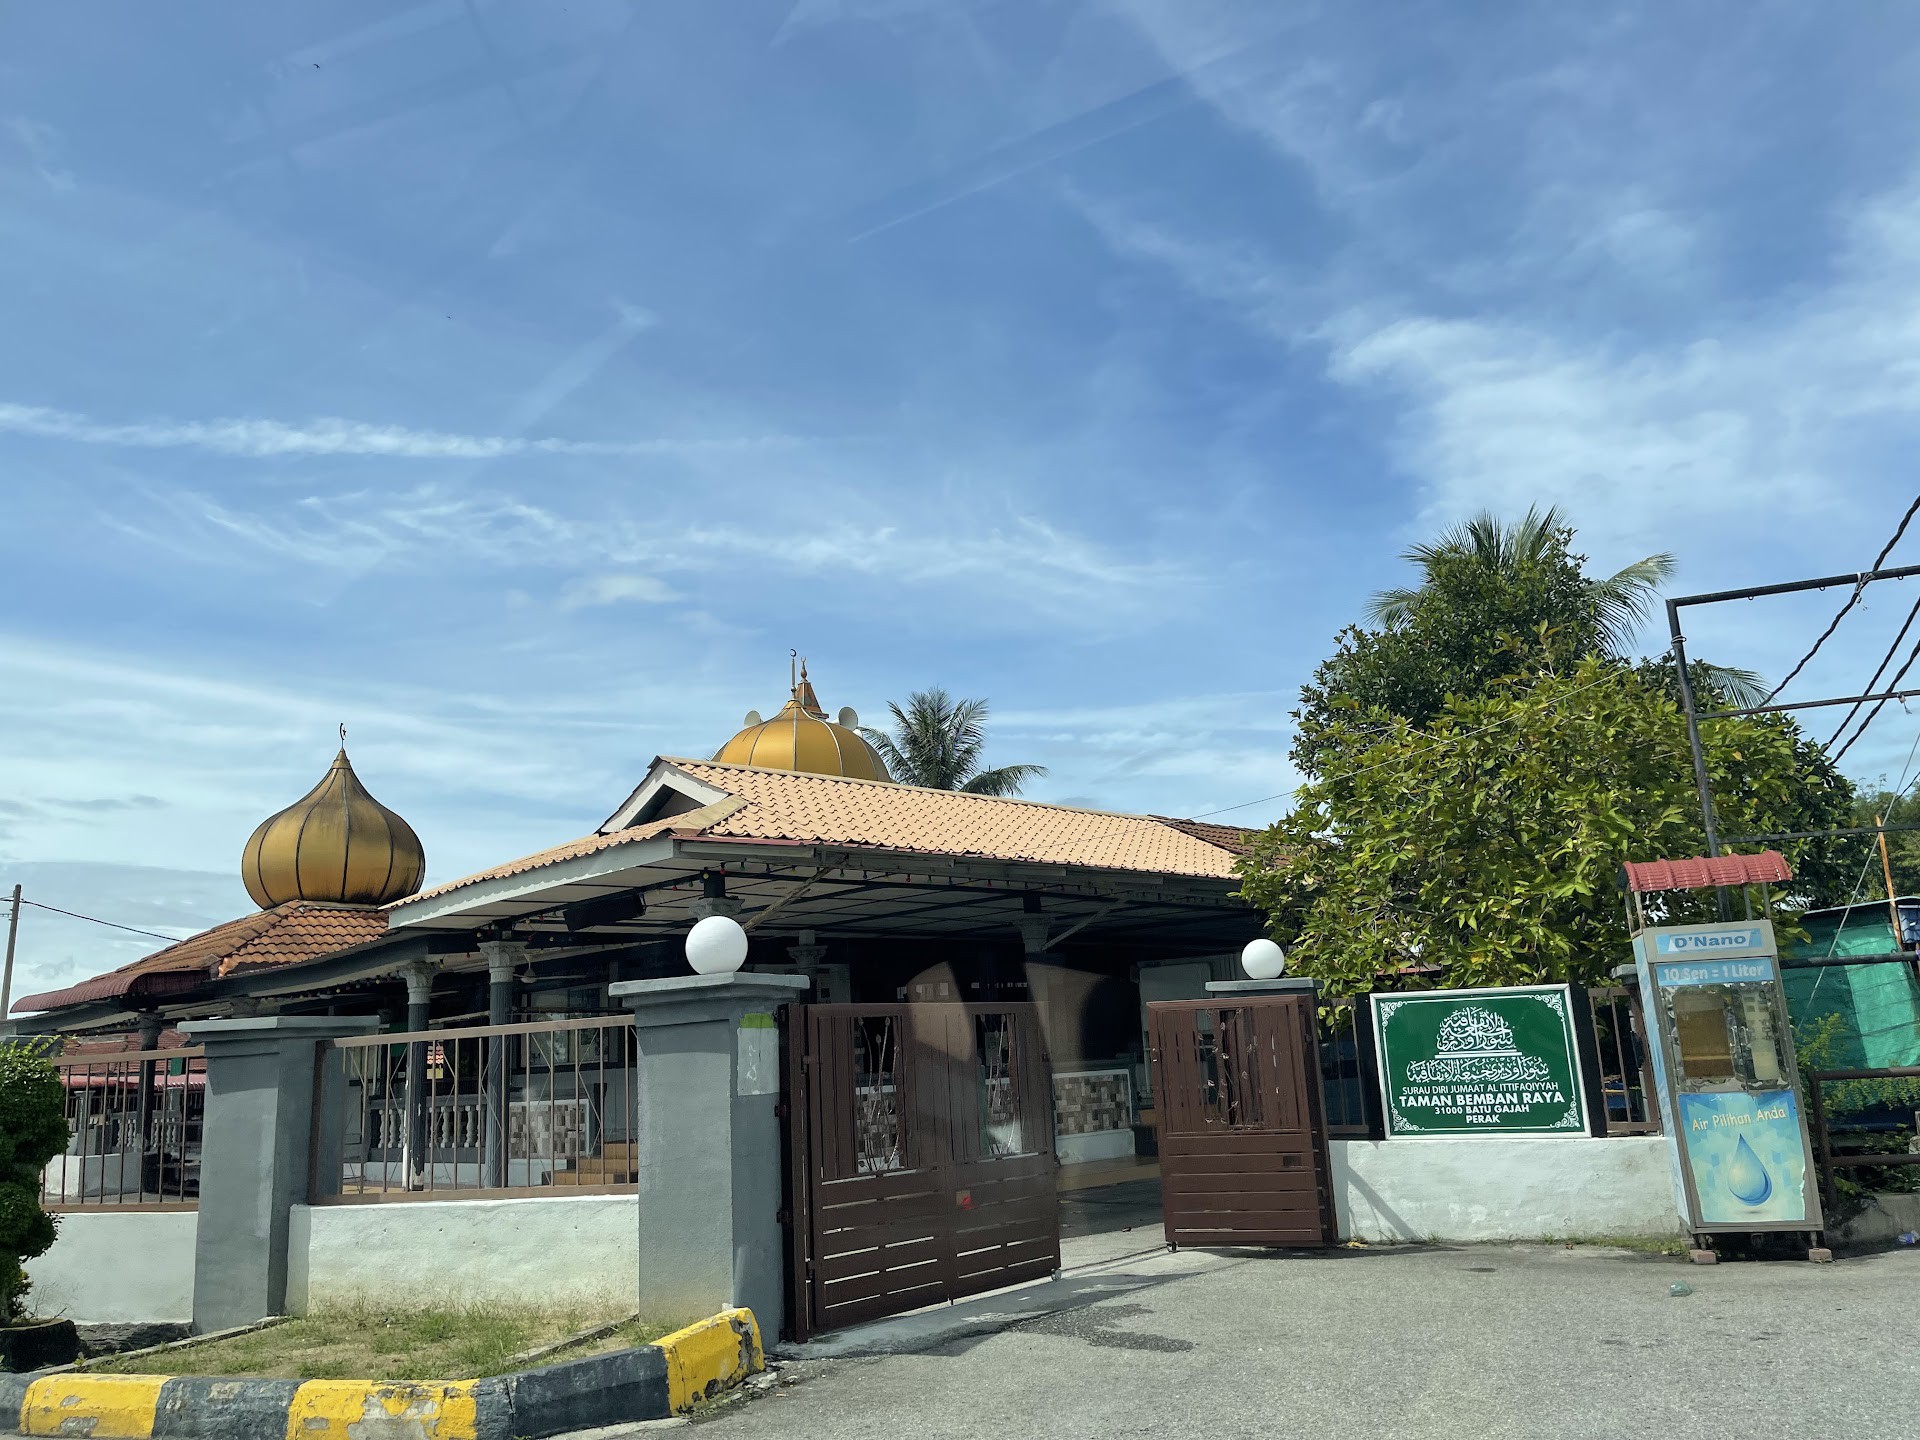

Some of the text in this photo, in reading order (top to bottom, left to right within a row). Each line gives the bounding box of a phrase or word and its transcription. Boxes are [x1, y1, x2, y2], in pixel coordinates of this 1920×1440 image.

[1663, 968, 1680, 981] 10
[1681, 967, 1709, 981] Sen
[1722, 965, 1729, 978] 1
[1731, 964, 1764, 978] Liter
[1402, 1082, 1559, 1095] SURAU DIRI JUMAAT AL ITTIFAQIYYAH
[1399, 1091, 1566, 1107] TAMAN BEMBAN RAYA
[1434, 1104, 1530, 1115] 31000 BATU GAJAH
[1466, 1114, 1501, 1124] PERAK
[1692, 1106, 1787, 1131] Air Pilihan Anda
